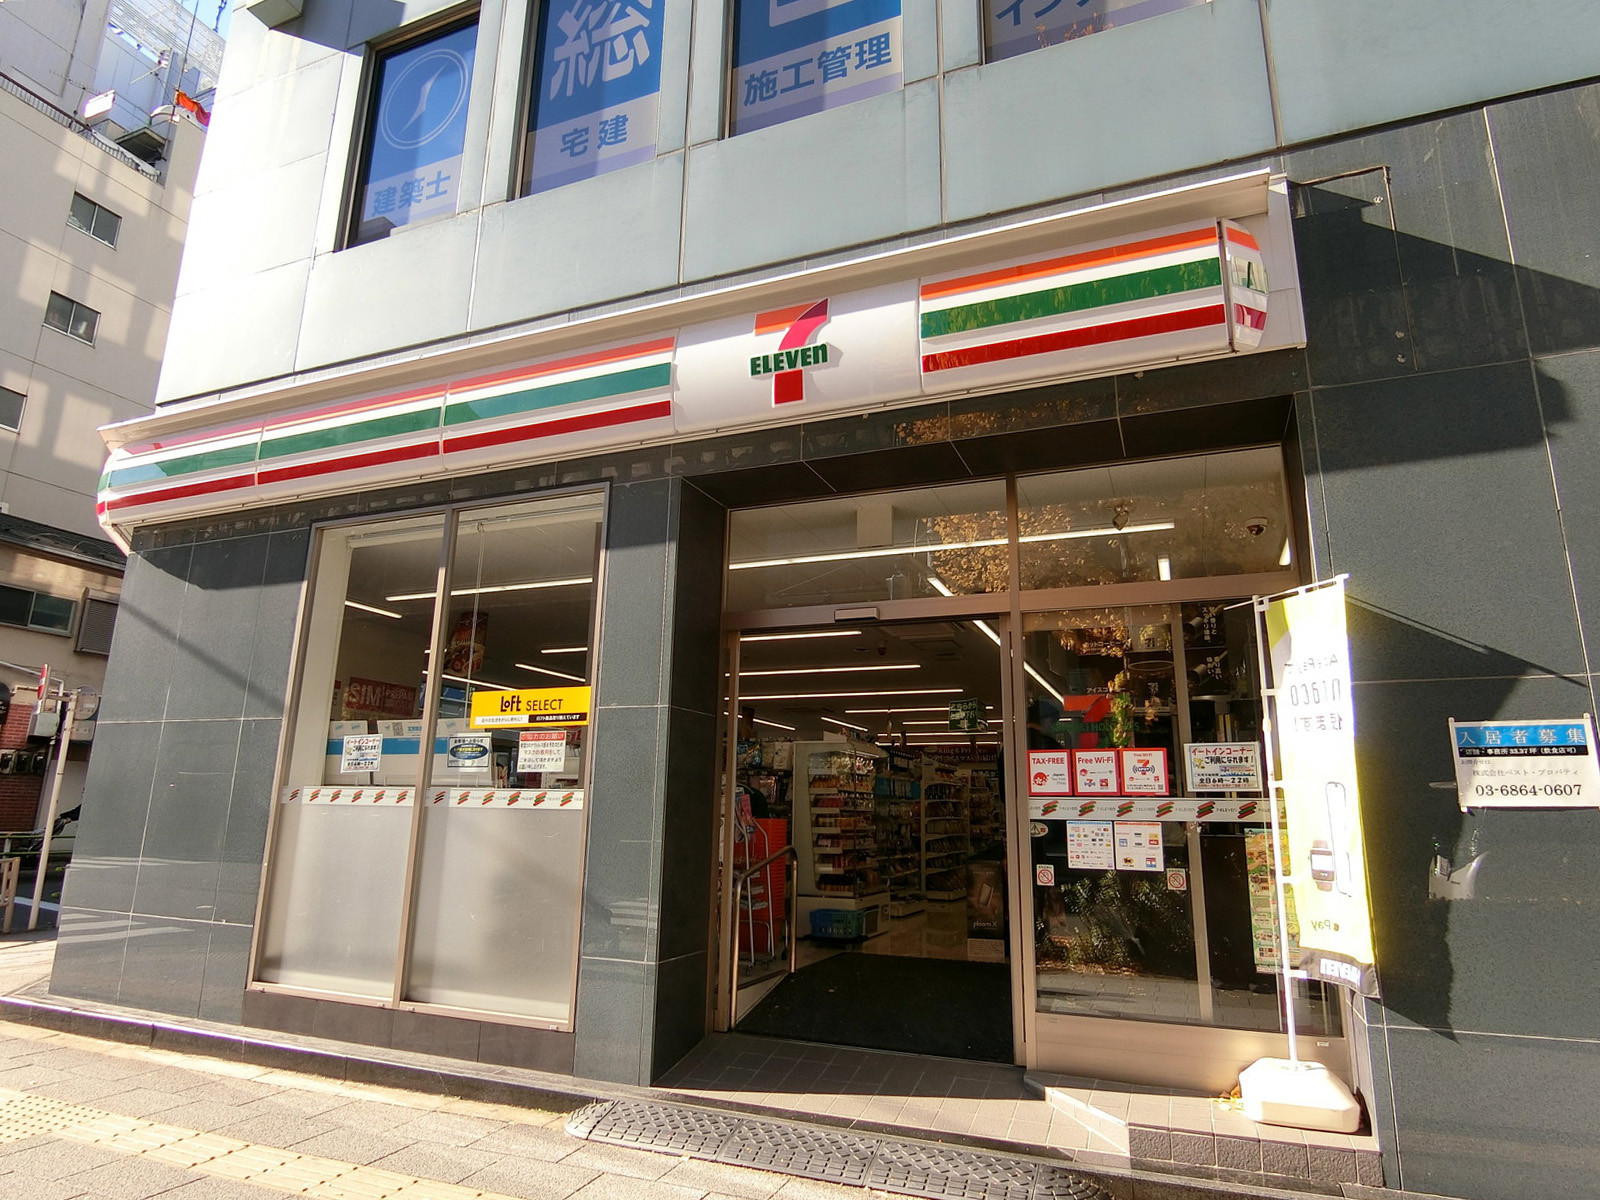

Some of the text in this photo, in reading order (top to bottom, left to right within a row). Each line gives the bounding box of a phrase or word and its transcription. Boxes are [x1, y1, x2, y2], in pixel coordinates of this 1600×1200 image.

[549, 0, 651, 101] 総
[744, 32, 892, 107] 施工管理
[560, 114, 628, 158] 宅建
[371, 171, 450, 217] 建築士
[525, 699, 563, 711] SELECT
[1458, 727, 1586, 745] 入居者募集
[1191, 746, 1253, 756] イートインコーナー
[1031, 757, 1065, 765] TAX-FREE
[1095, 756, 1114, 764] Wi-Fi
[1475, 784, 1582, 796] 03-6864-0607
